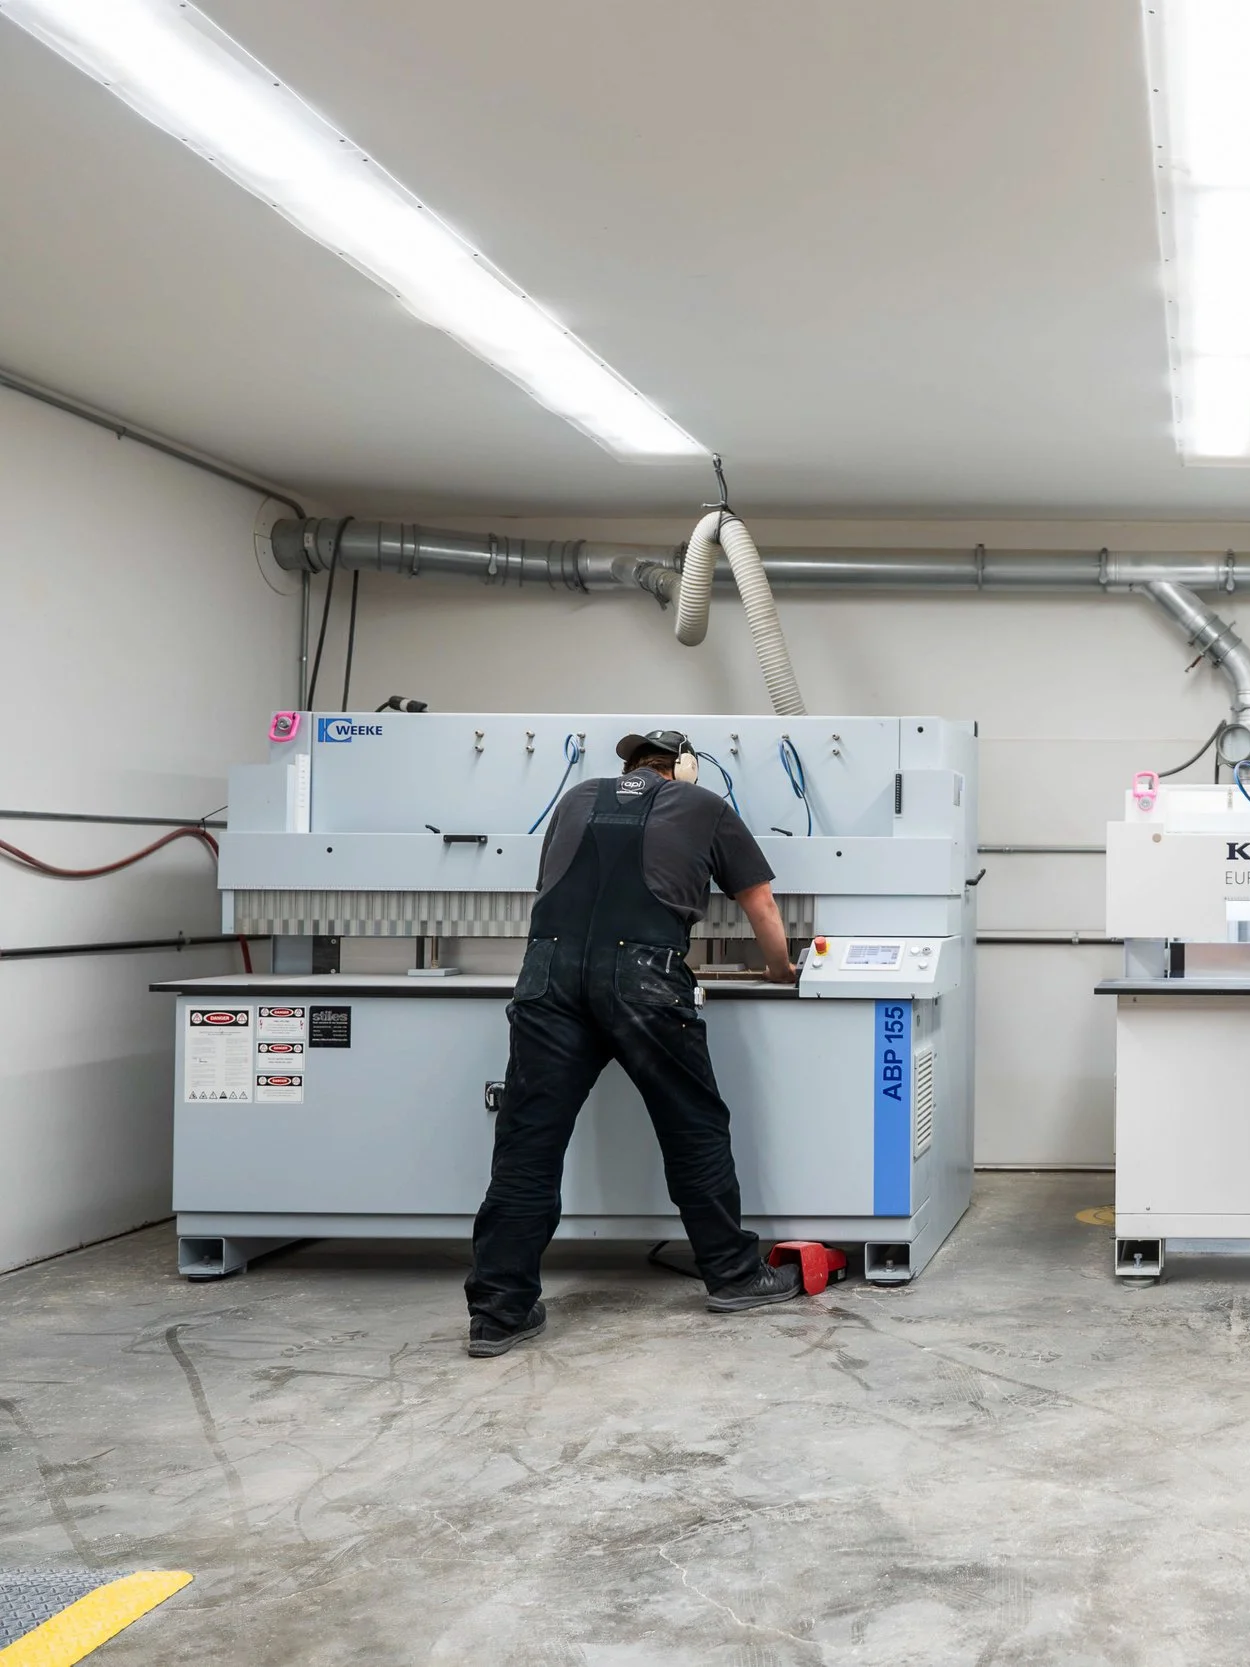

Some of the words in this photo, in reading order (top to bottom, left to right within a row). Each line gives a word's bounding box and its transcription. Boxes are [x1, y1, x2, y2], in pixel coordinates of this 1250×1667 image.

[336, 725, 383, 736] WEEKE
[312, 1010, 348, 1022] stiles
[884, 1006, 904, 1044] 155
[882, 1048, 903, 1102] ABP
